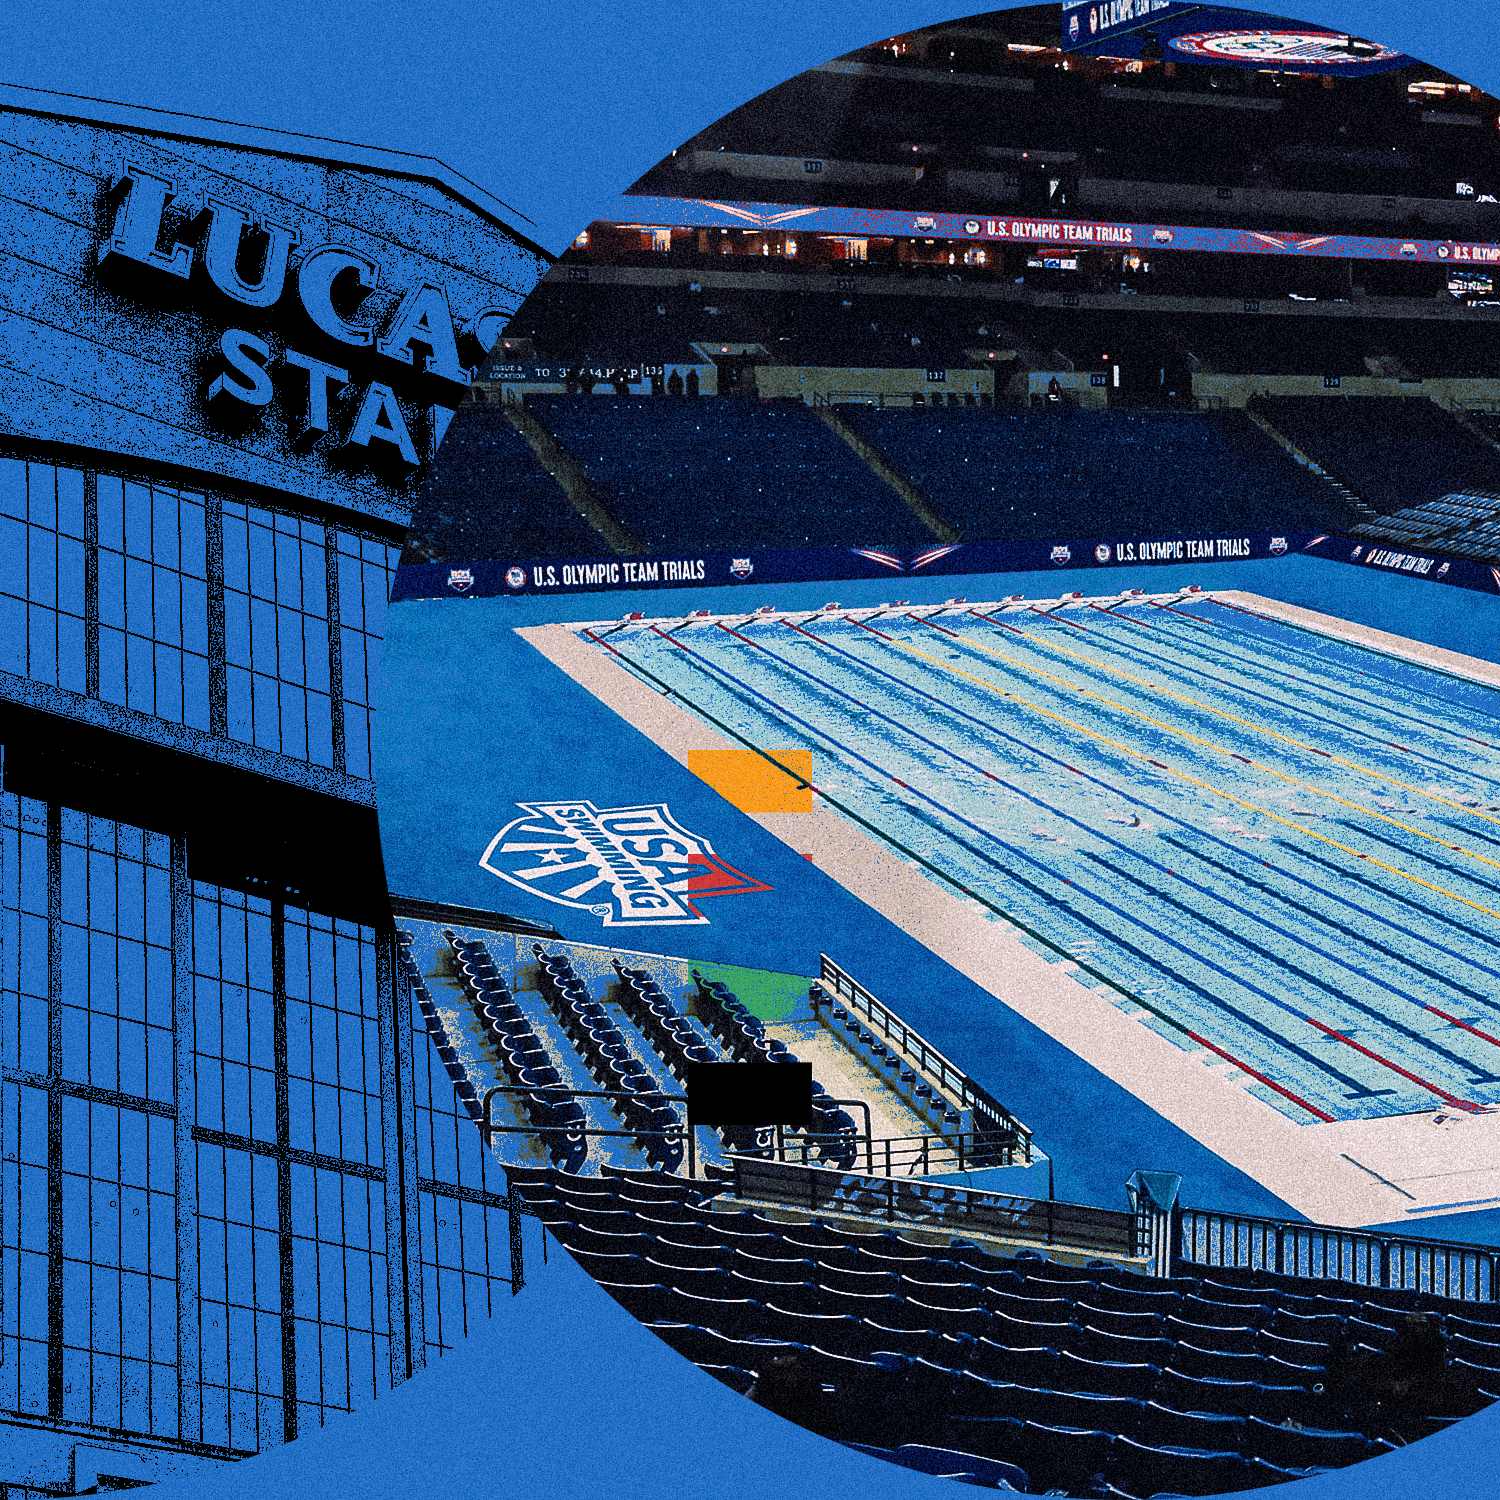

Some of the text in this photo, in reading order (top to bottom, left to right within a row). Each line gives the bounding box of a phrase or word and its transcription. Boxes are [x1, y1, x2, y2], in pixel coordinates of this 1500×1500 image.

[987, 221, 1133, 243] U.S. OLYMPIC TEAM TRIALS
[1454, 246, 1472, 260] U.S.
[535, 368, 550, 377] TO
[1116, 537, 1251, 561] U.S. OLYMPIC TEAM TRIALS
[533, 558, 706, 587] U.S. OLYMPIC TEAM TRIALS
[600, 815, 715, 890] USA
